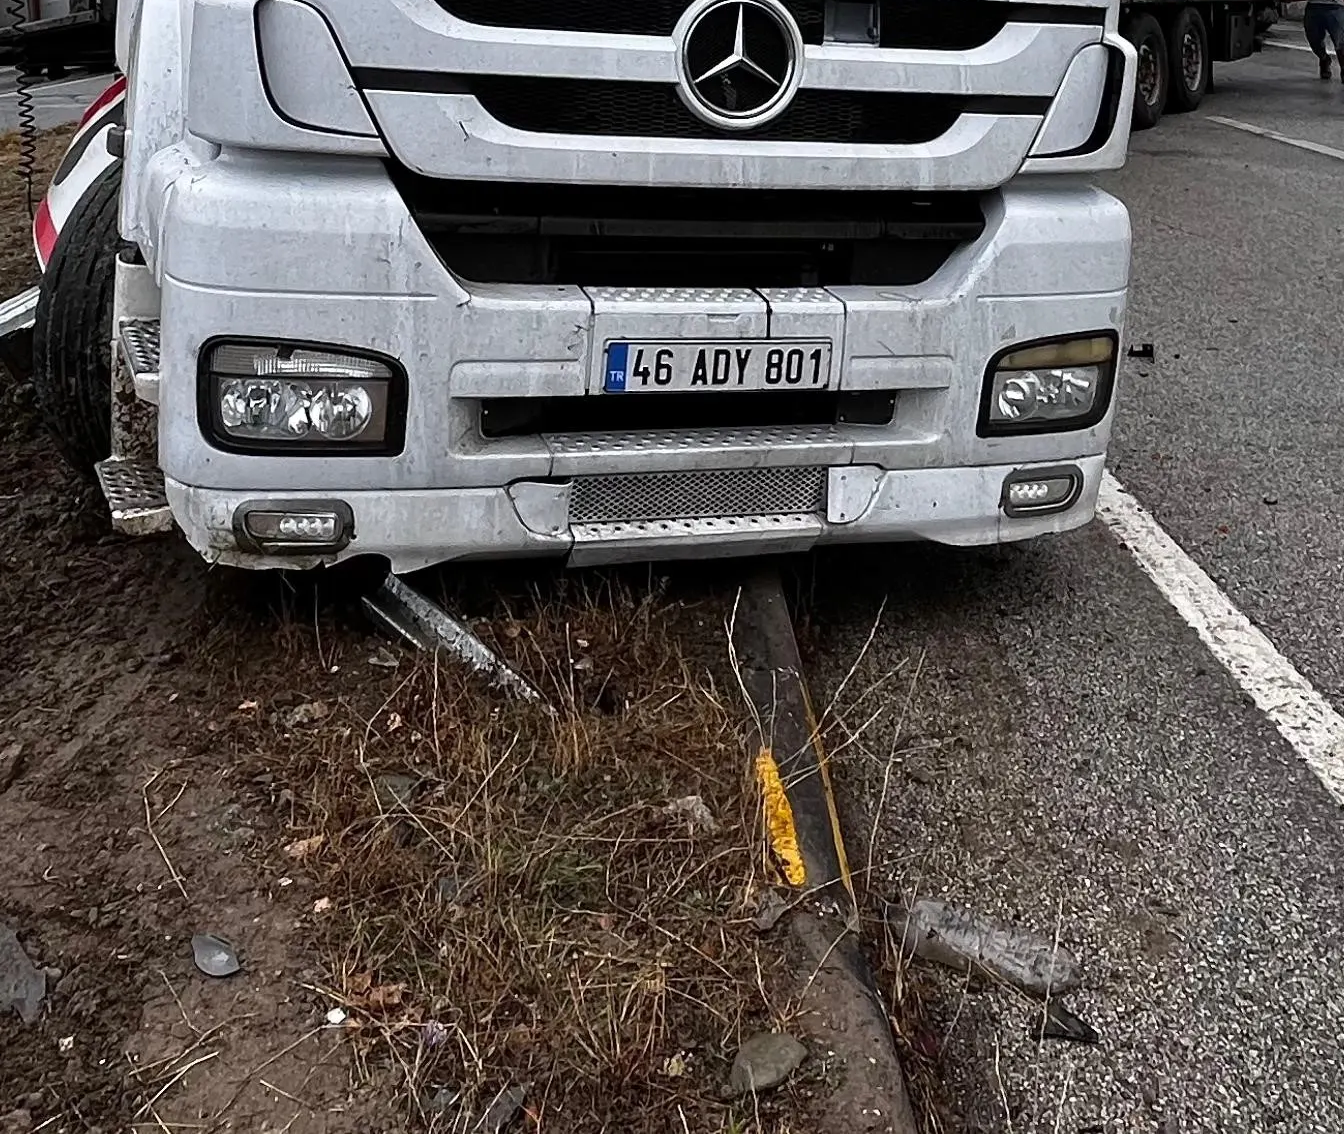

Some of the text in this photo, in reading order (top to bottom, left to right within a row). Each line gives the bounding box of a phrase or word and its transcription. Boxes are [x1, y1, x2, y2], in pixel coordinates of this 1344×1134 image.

[609, 370, 624, 382] TR
[632, 347, 823, 386] 46 ADY 801
